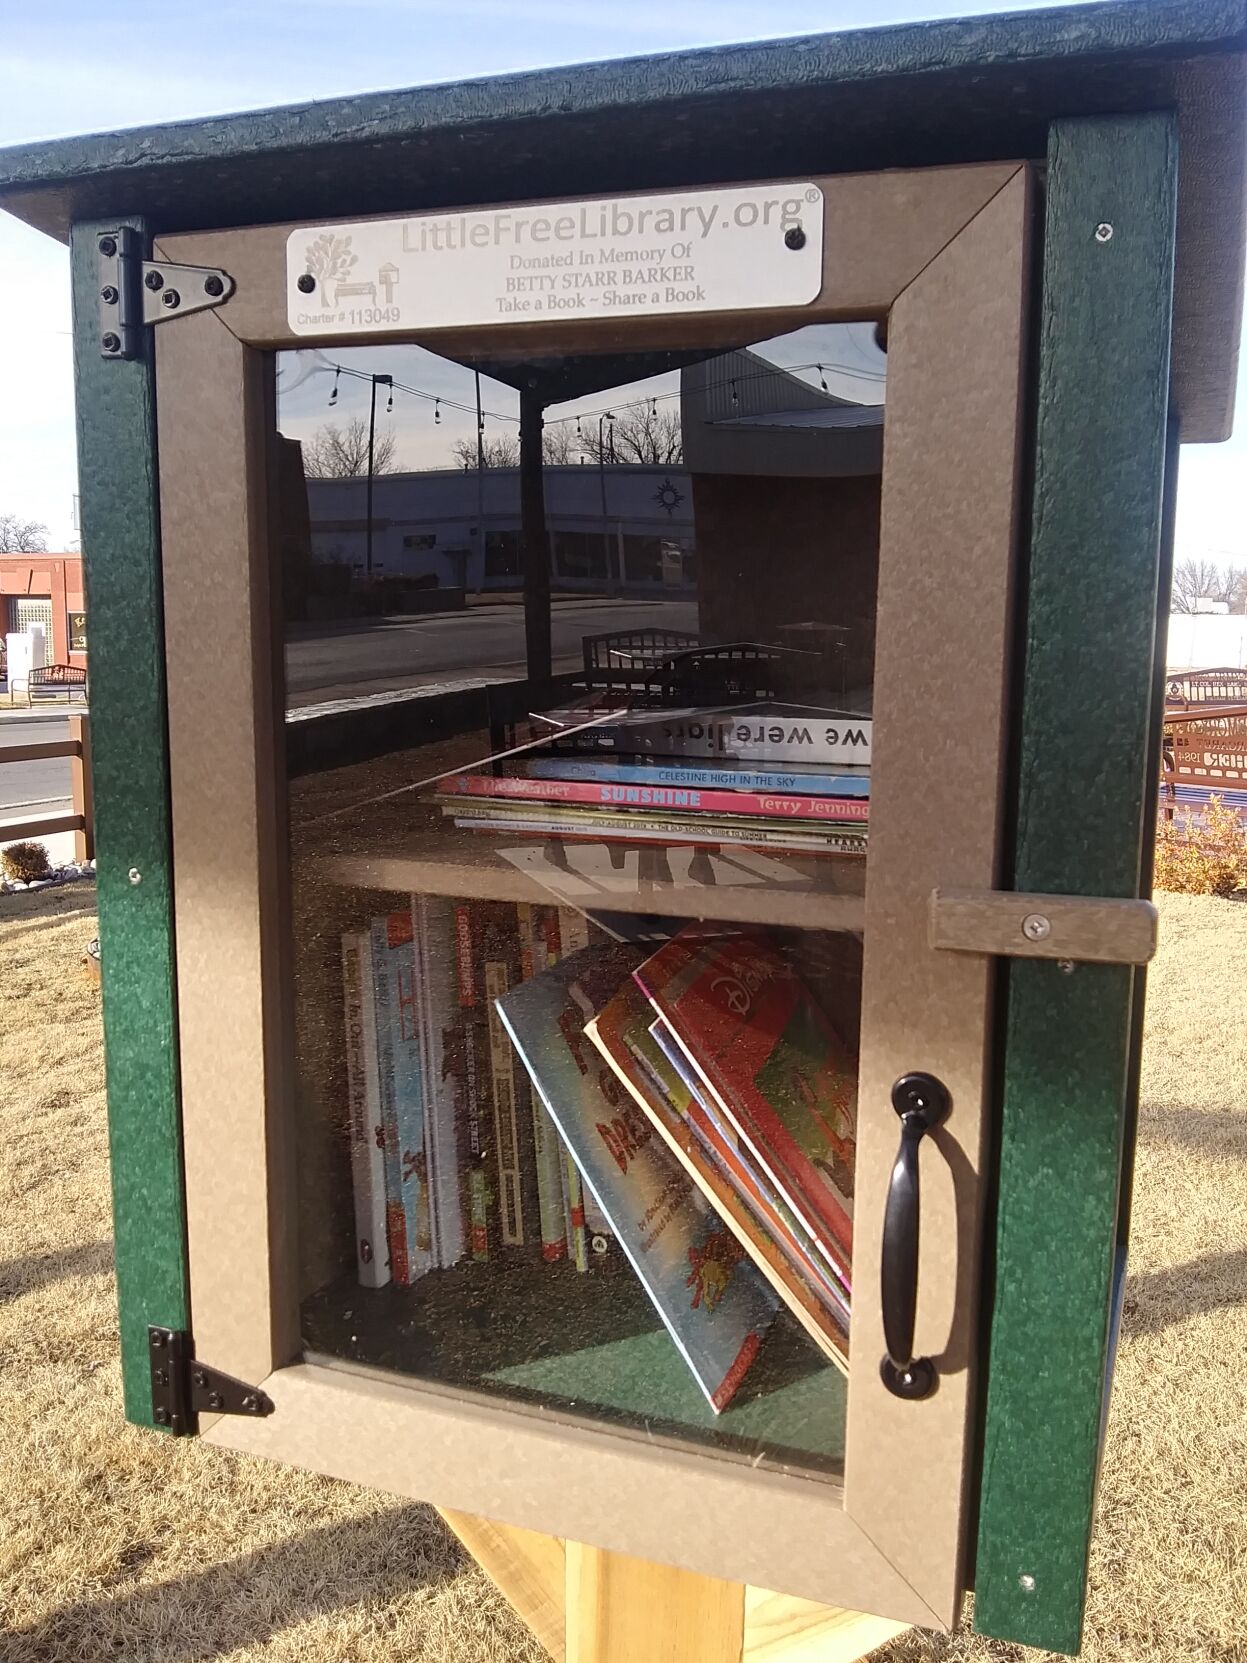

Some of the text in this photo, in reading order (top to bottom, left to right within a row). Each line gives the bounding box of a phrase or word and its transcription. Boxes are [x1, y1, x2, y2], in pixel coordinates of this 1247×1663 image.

[510, 241, 693, 270] Donated In Memory Of
[506, 265, 695, 293] BETTY STARR BARKER
[496, 297, 530, 313] Take
[534, 299, 543, 310] a
[547, 293, 586, 310] Book
[602, 289, 647, 306] Share
[651, 292, 660, 304] a
[665, 285, 706, 303] Book
[296, 307, 400, 325] Charter # 113049
[736, 725, 814, 745] were
[824, 727, 869, 747] we
[658, 771, 797, 788] CELESTINE HIGH IN THE SKY
[600, 787, 701, 807] SUNSHINE
[756, 796, 802, 814] Terry
[459, 914, 474, 996] GOOSEBUMPS
